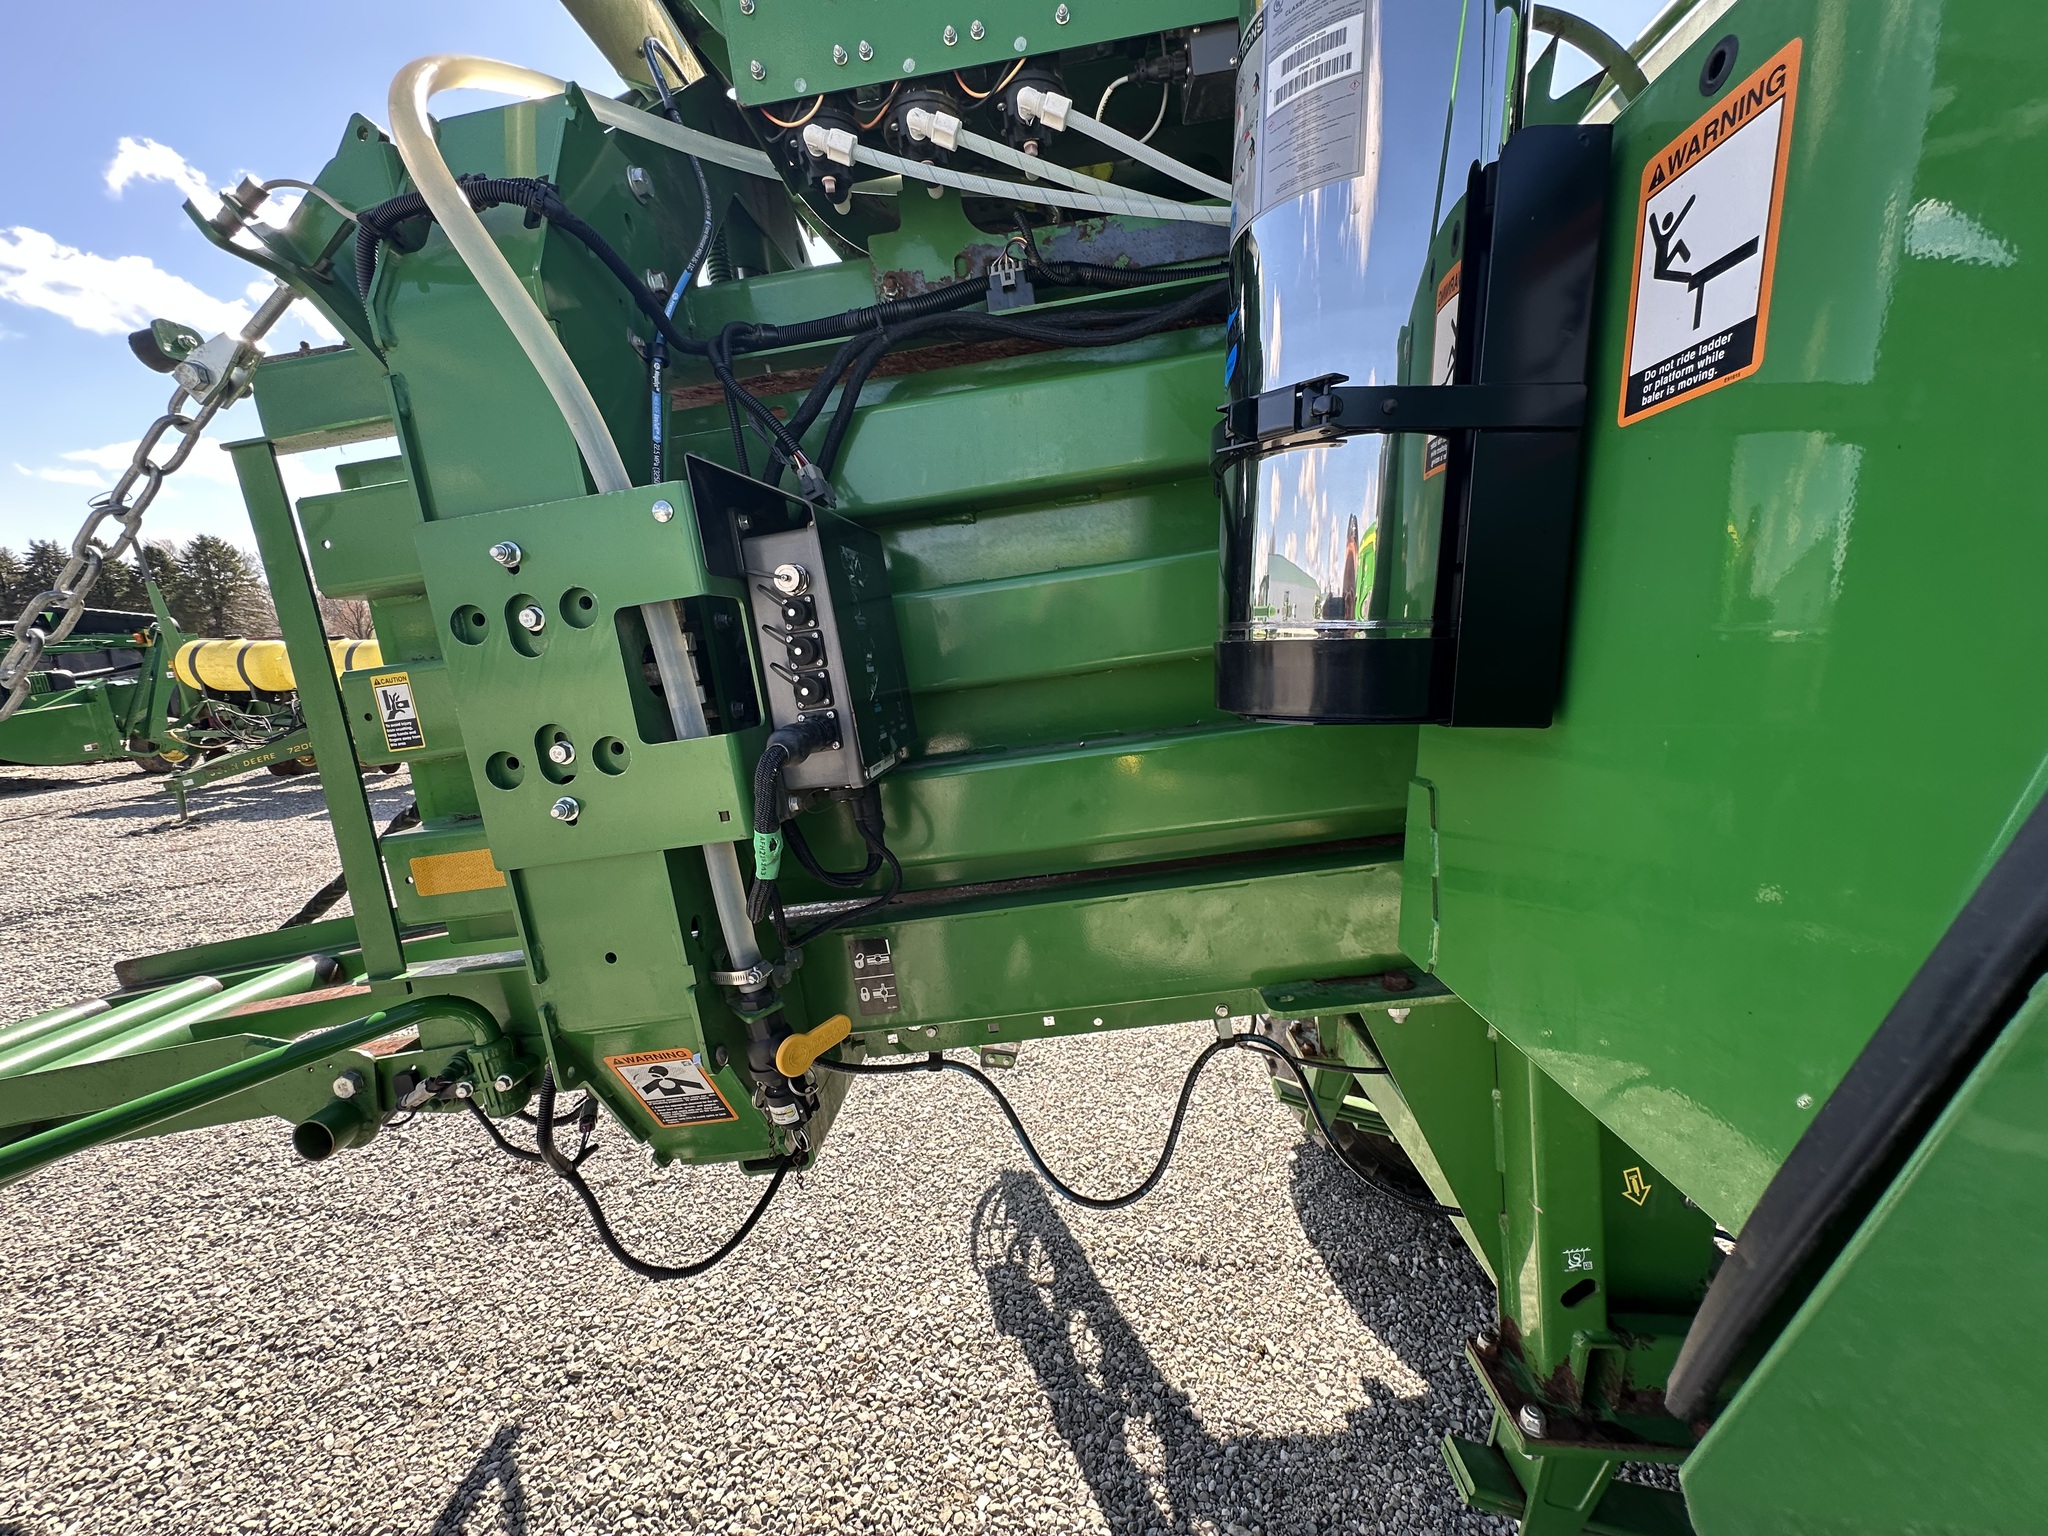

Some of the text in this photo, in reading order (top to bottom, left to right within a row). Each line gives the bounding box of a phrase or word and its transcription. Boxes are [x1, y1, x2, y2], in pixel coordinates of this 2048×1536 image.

[1668, 64, 1787, 175] WARNING
[1642, 350, 1725, 394] or platform while
[1644, 333, 1733, 382] Do not ride ladder
[1641, 367, 1718, 406] baler is moving.
[380, 676, 408, 685] CAUTION
[243, 752, 277, 767] DEERE
[622, 1050, 688, 1064] WARNING
